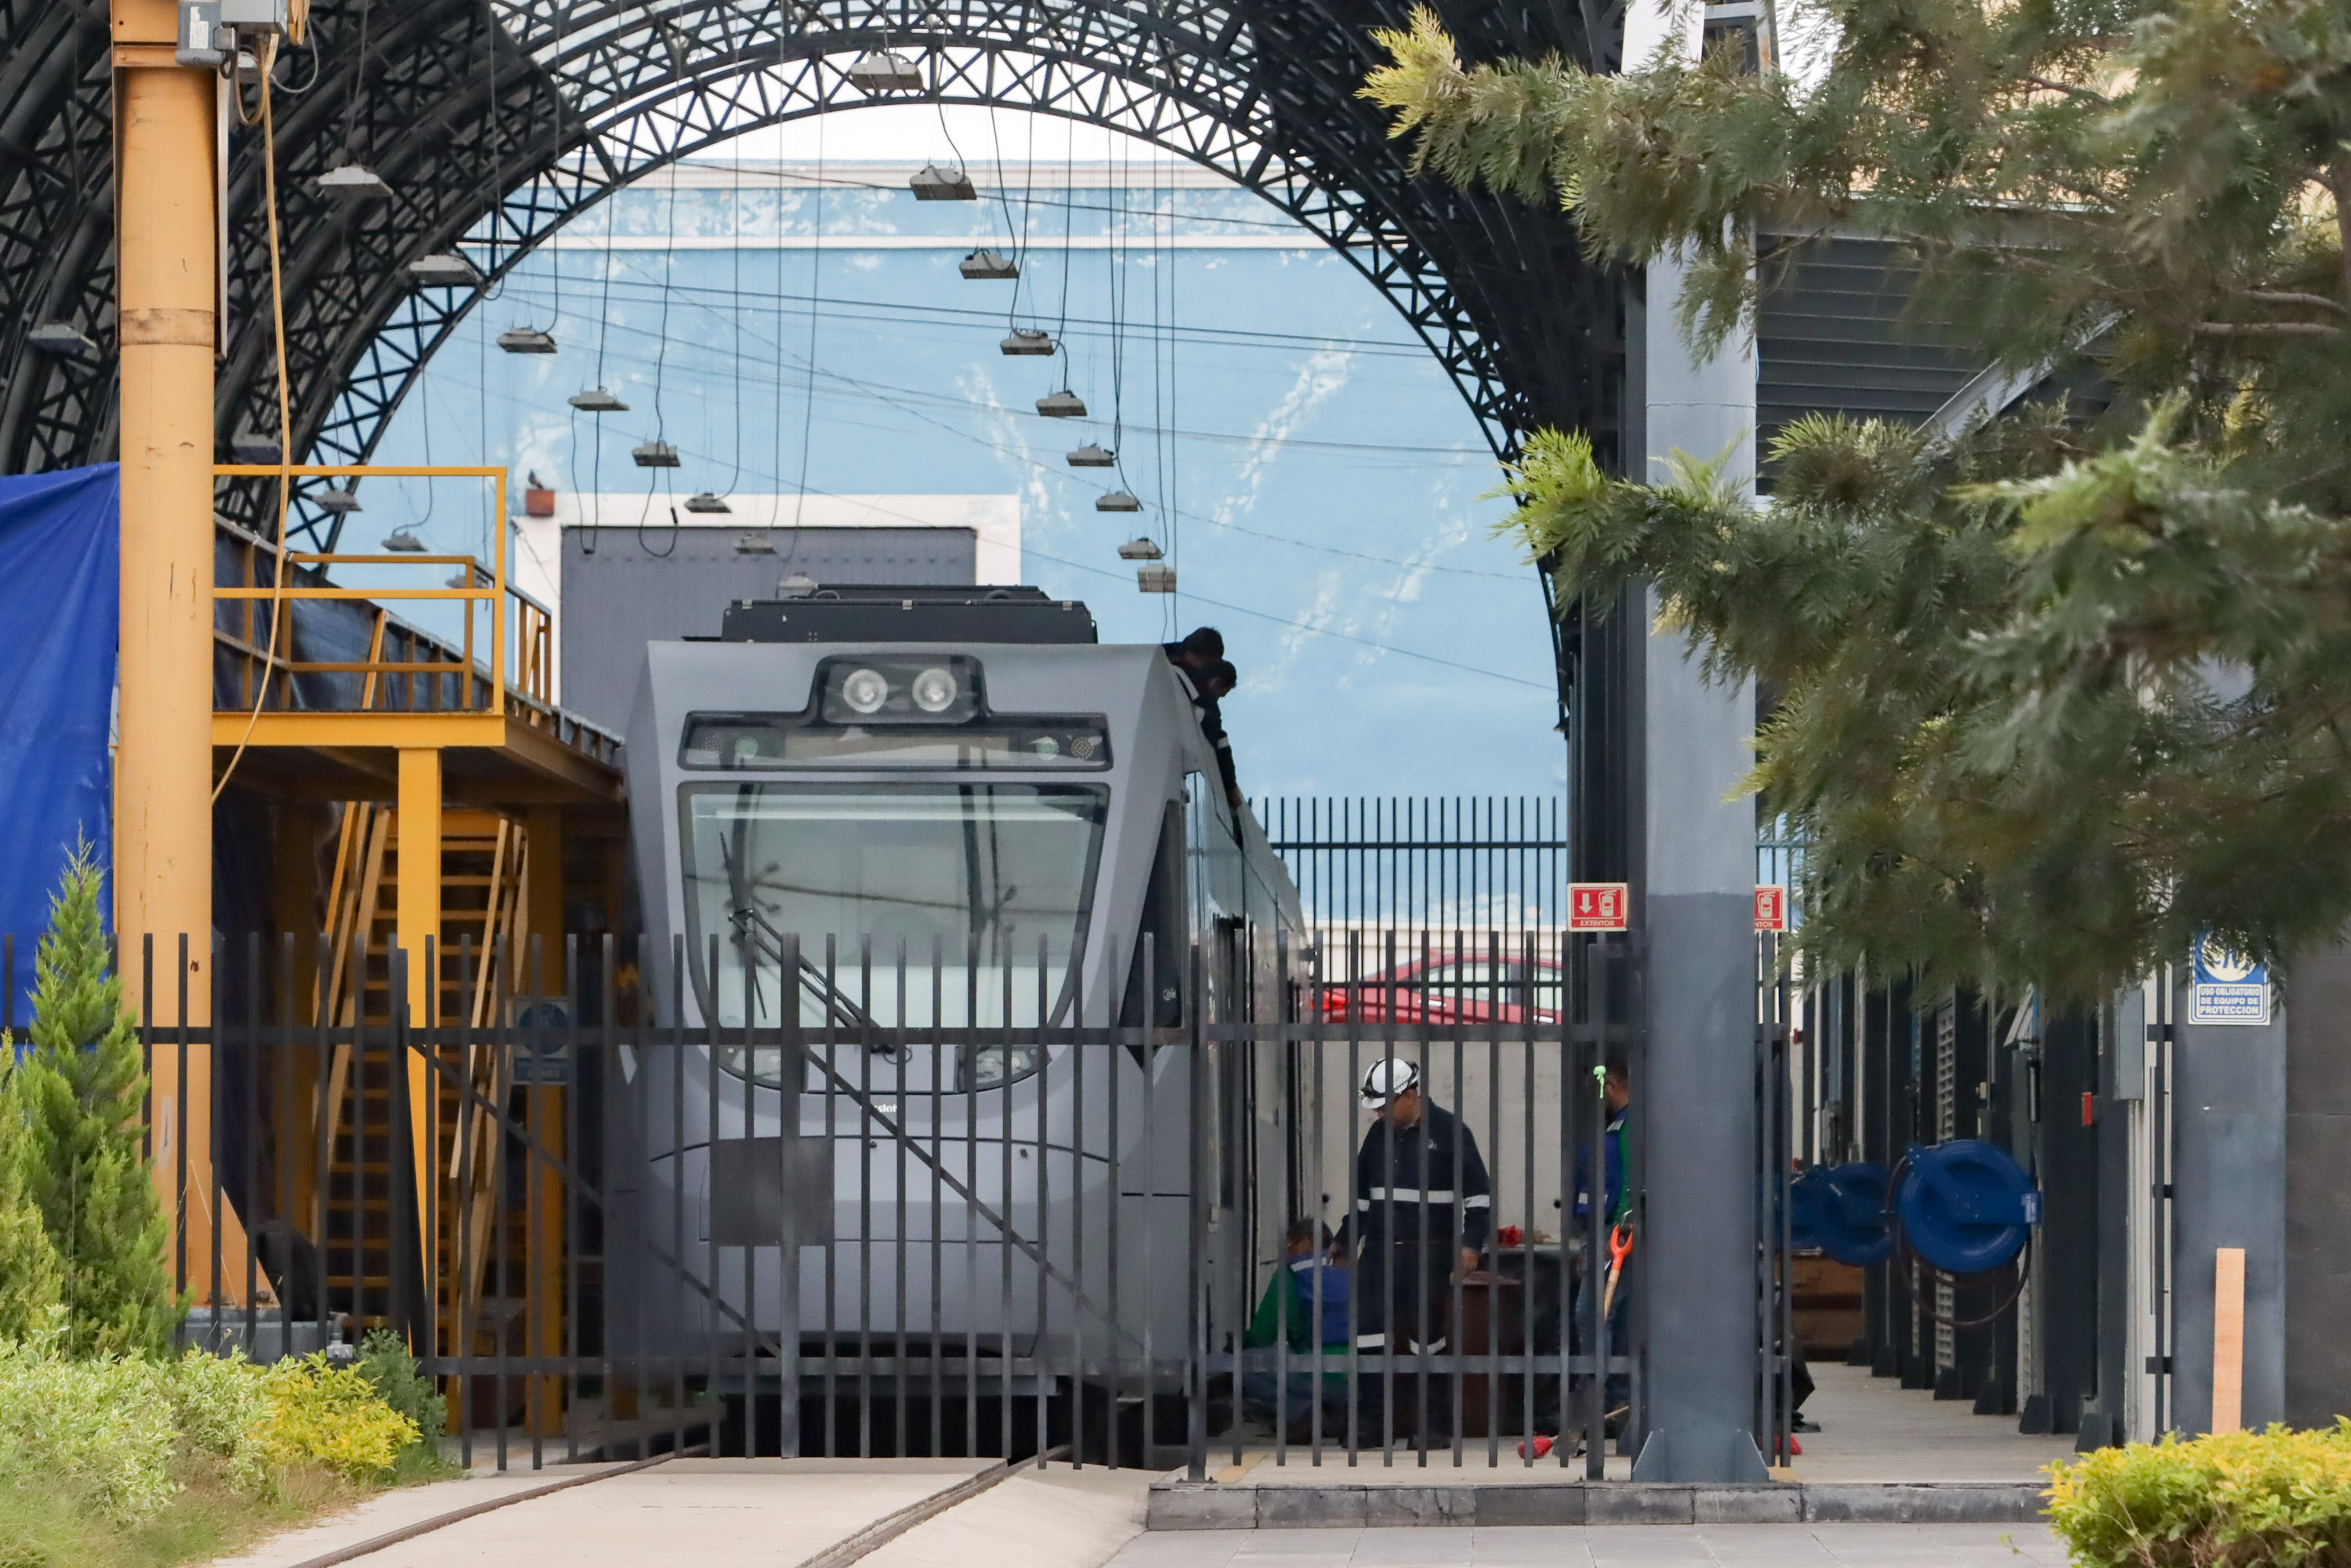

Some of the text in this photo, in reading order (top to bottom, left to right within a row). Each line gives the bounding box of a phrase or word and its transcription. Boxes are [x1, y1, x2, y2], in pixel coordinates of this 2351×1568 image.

[2200, 987, 2260, 996] USO OBLIGATORIO
[2200, 1005, 2259, 1014] PROTECCION
